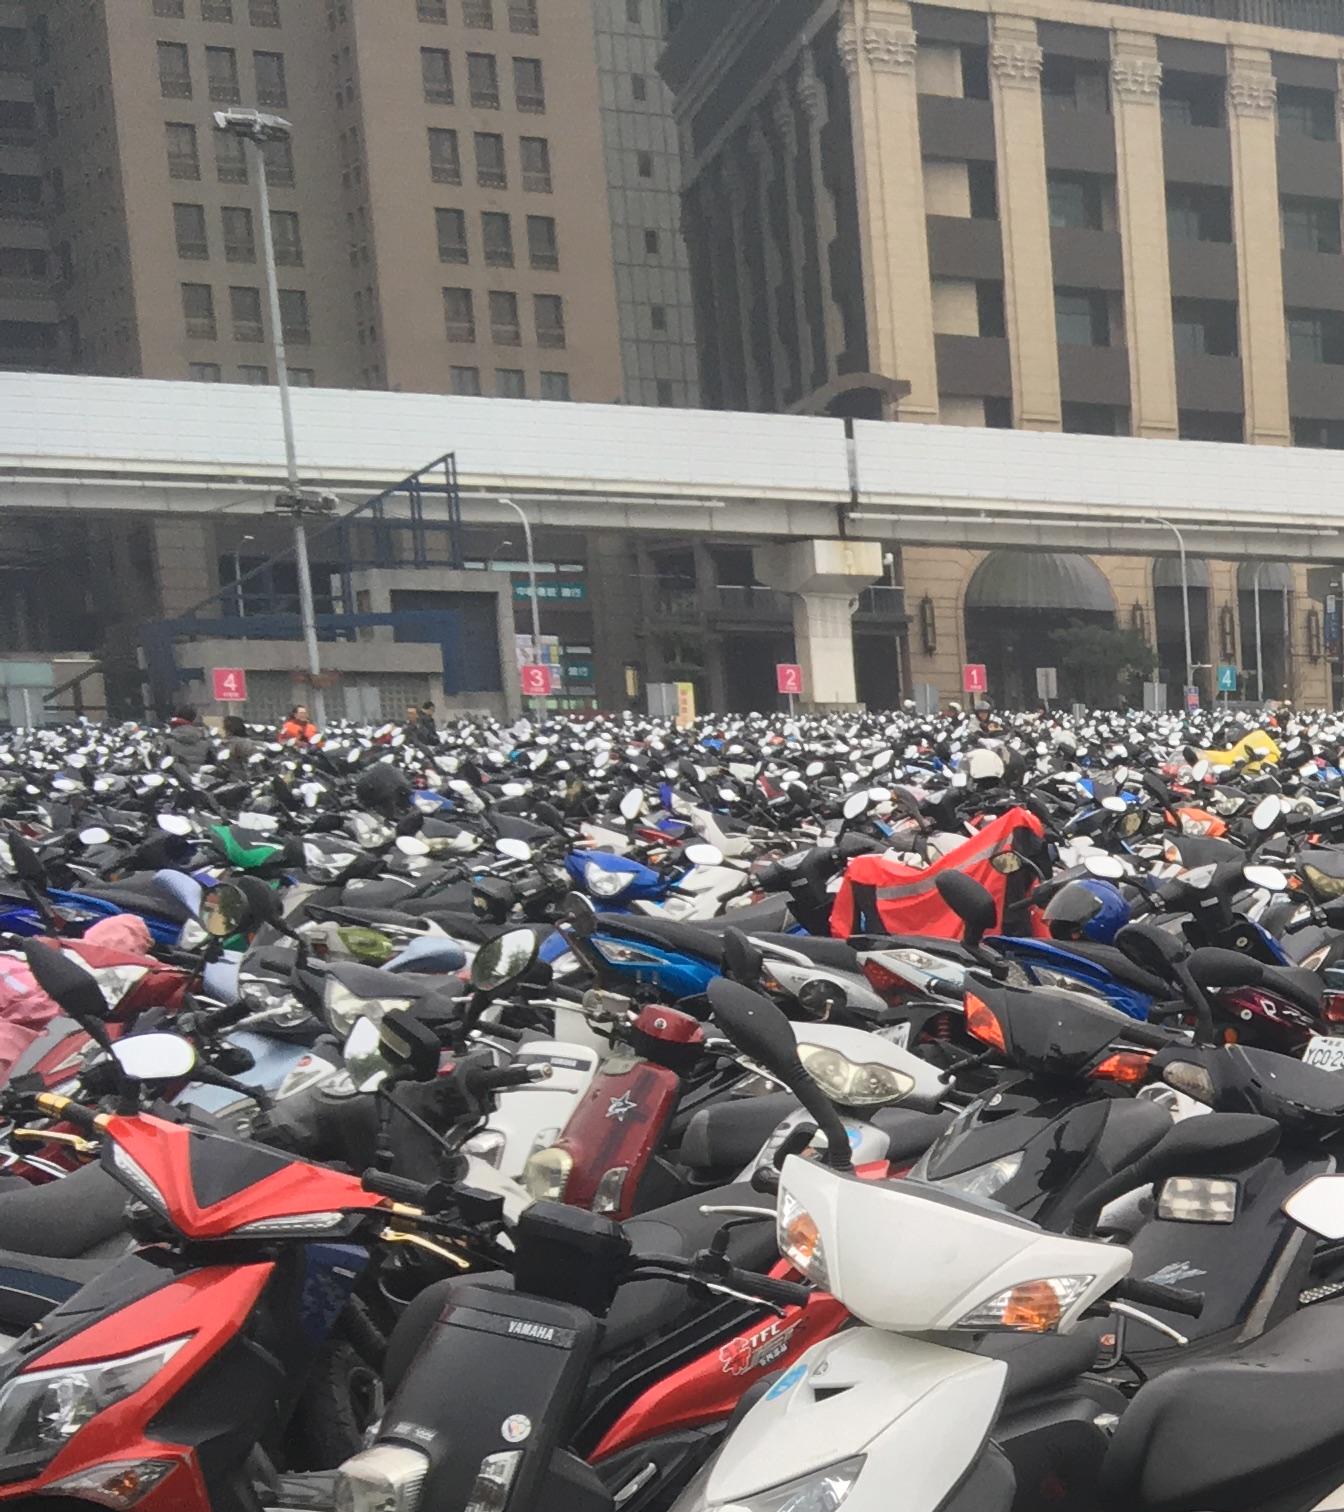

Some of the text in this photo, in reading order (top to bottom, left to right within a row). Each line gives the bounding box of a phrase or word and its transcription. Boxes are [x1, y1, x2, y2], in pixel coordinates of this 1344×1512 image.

[223, 672, 239, 692] 4
[529, 669, 545, 687] 3
[786, 669, 796, 686] 2
[970, 669, 978, 685] 1
[1222, 671, 1232, 687] 4
[508, 1320, 554, 1342] YAMAHA
